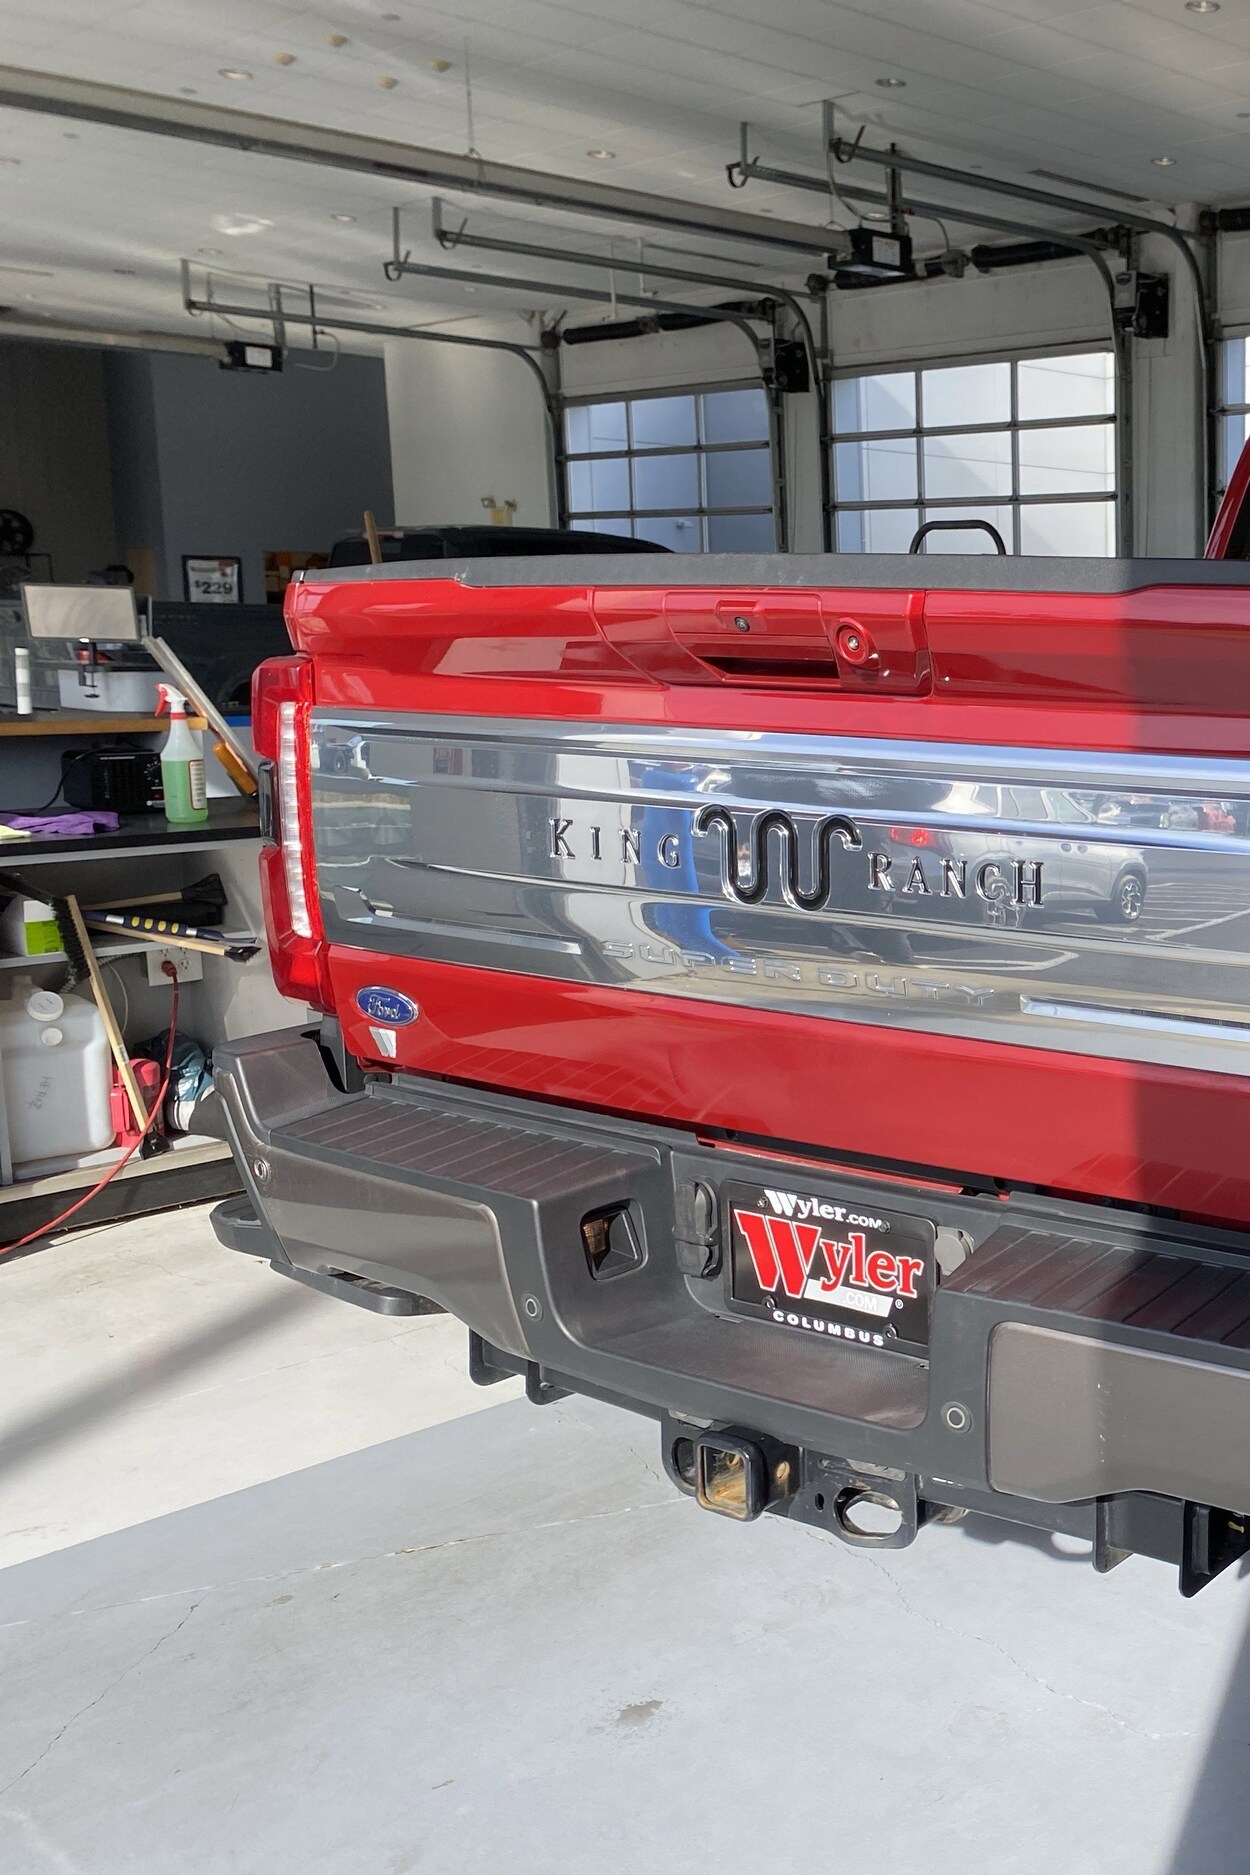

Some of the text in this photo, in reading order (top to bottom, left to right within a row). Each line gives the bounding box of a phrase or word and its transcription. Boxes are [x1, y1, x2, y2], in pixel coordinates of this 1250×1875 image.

[548, 817, 1045, 909] KING RANCH
[602, 940, 996, 1006] SUPER DUTY
[368, 994, 401, 1020] Ford
[733, 1208, 925, 1299] Wyler
[842, 1291, 880, 1312] .COM
[772, 1310, 886, 1348] COLUMBUS
